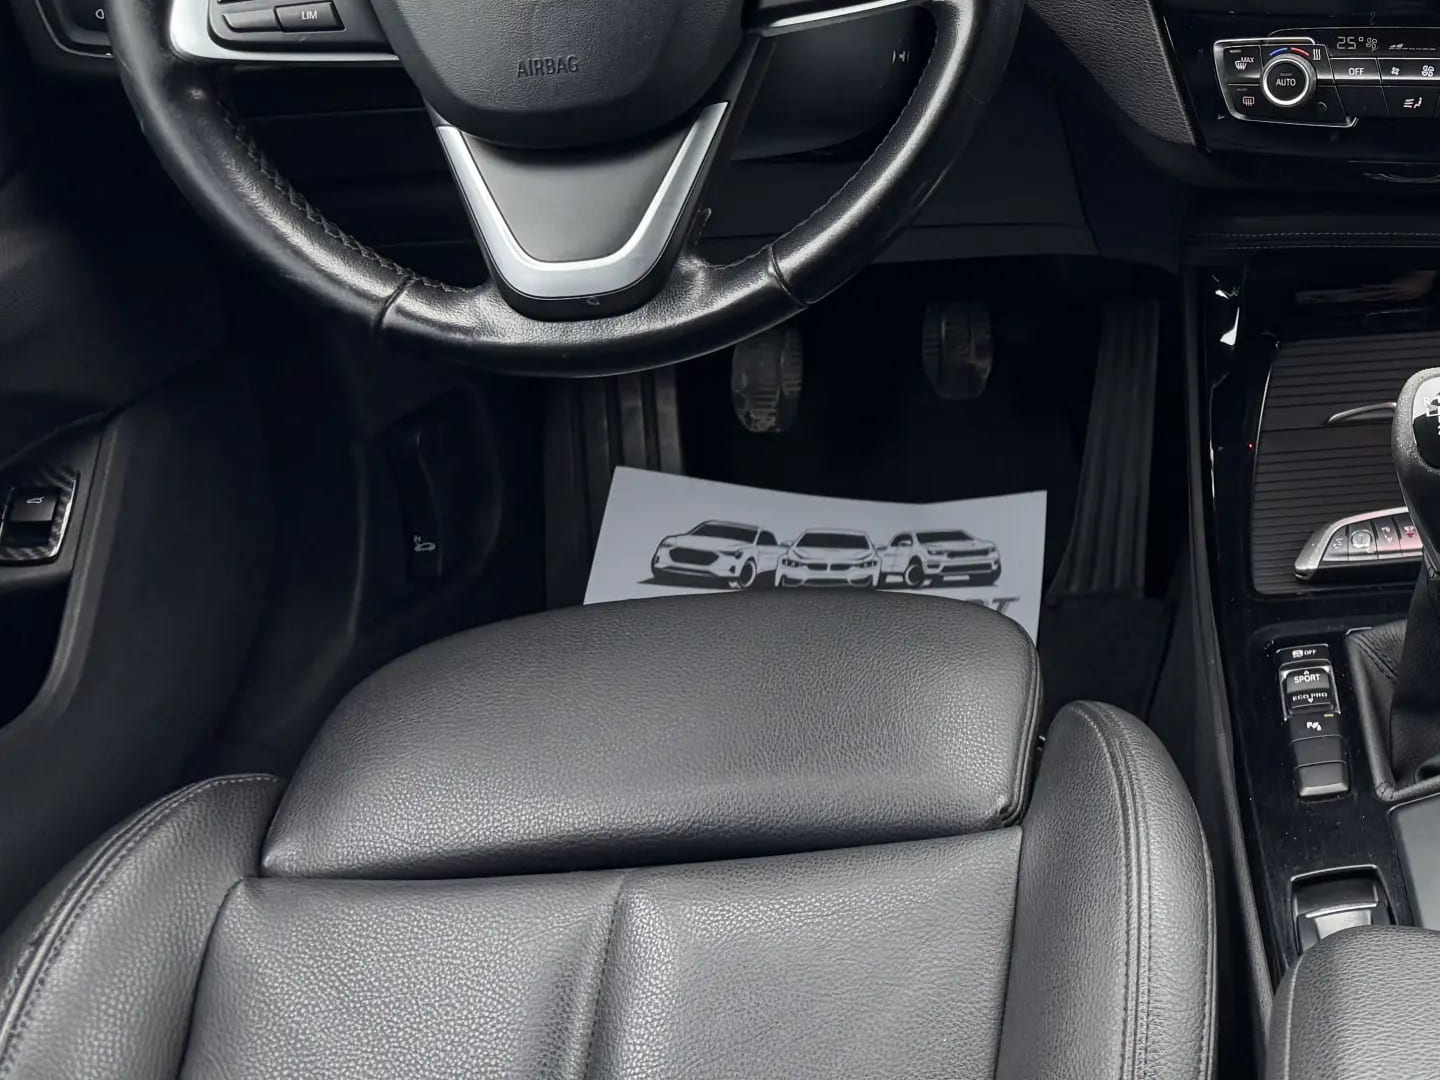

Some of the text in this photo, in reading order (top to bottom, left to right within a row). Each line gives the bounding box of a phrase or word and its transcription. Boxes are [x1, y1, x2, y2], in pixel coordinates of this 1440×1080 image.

[301, 10, 318, 20] LIM
[516, 55, 579, 77] AIRBAG
[1348, 67, 1365, 76] OFF
[1275, 78, 1296, 87] AUTO
[1294, 673, 1321, 684] SPORT
